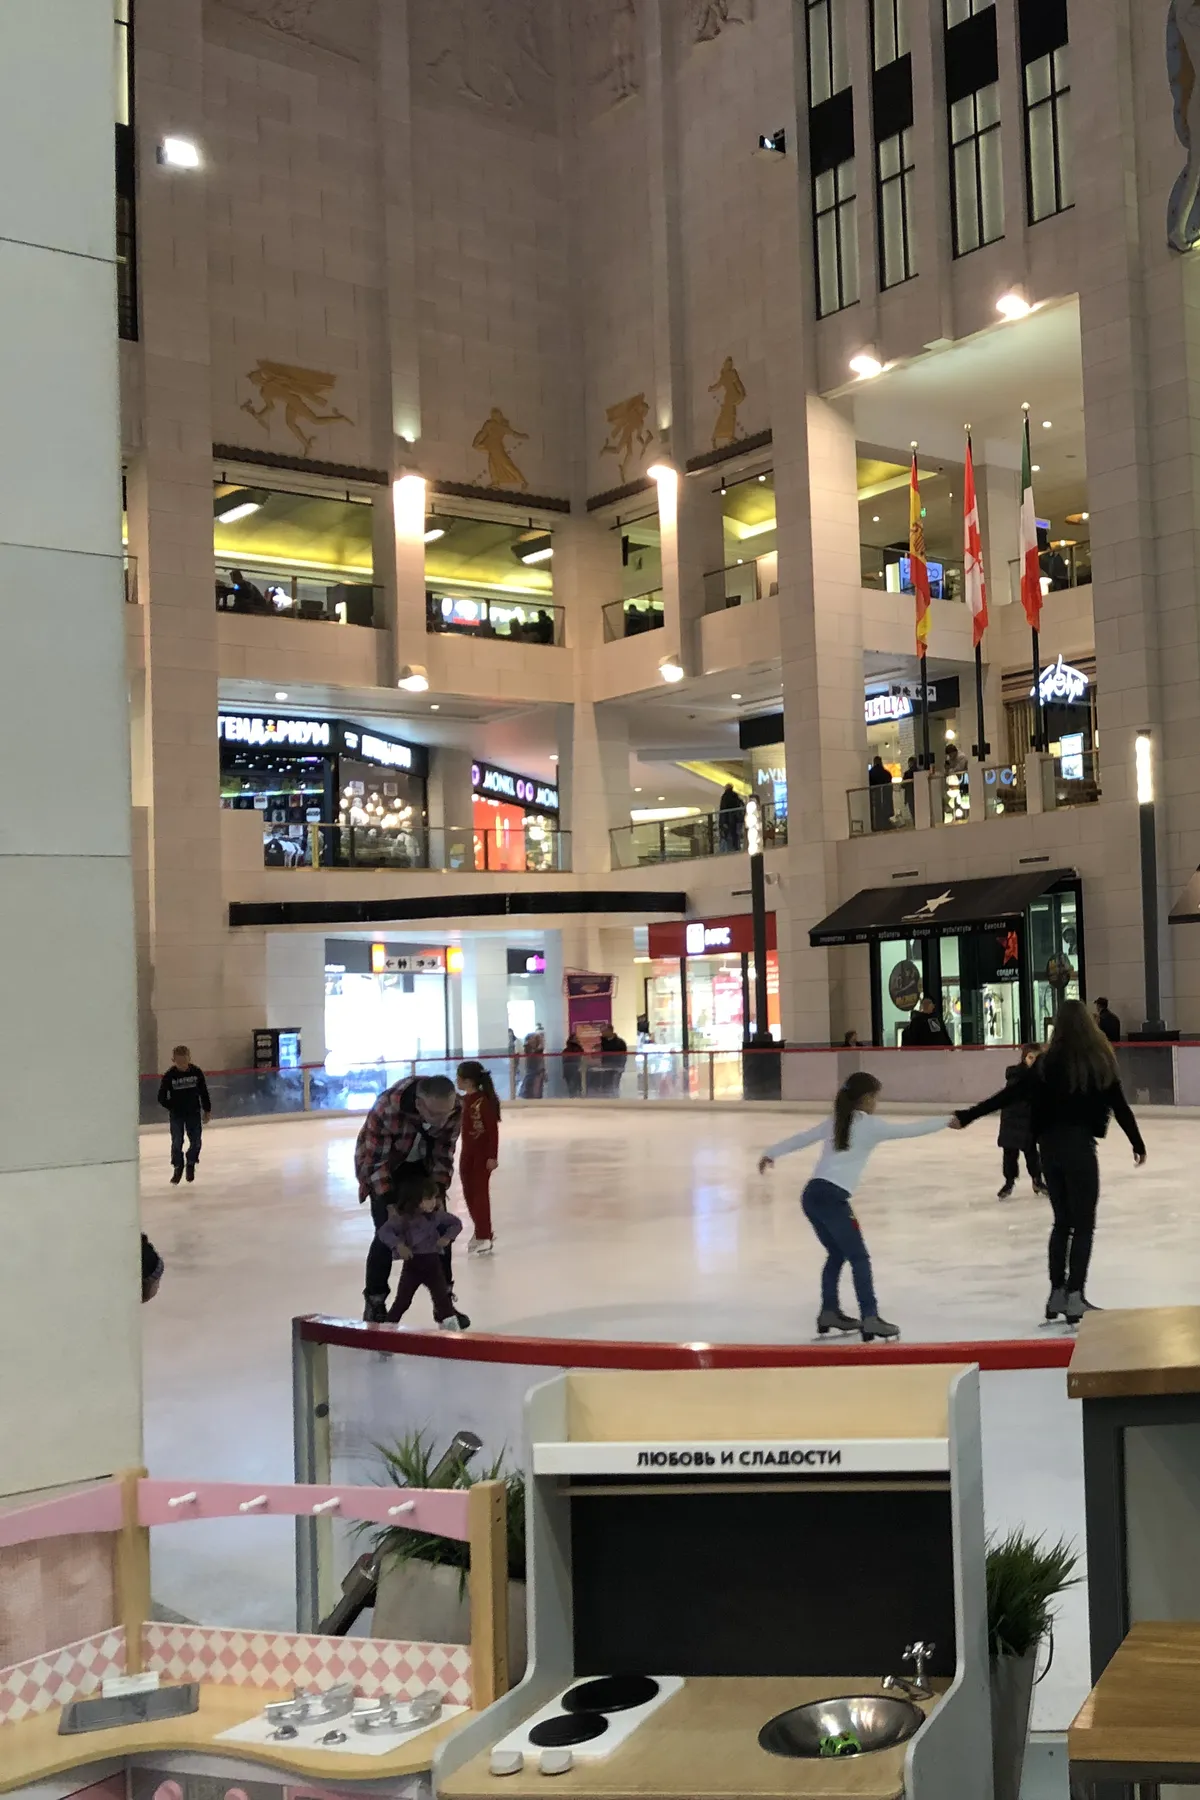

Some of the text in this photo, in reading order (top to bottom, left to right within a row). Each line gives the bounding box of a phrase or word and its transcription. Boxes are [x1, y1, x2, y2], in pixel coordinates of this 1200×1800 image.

[636, 1449, 842, 1466] ЛЮБОВЬ И СЛАДОСТИ
